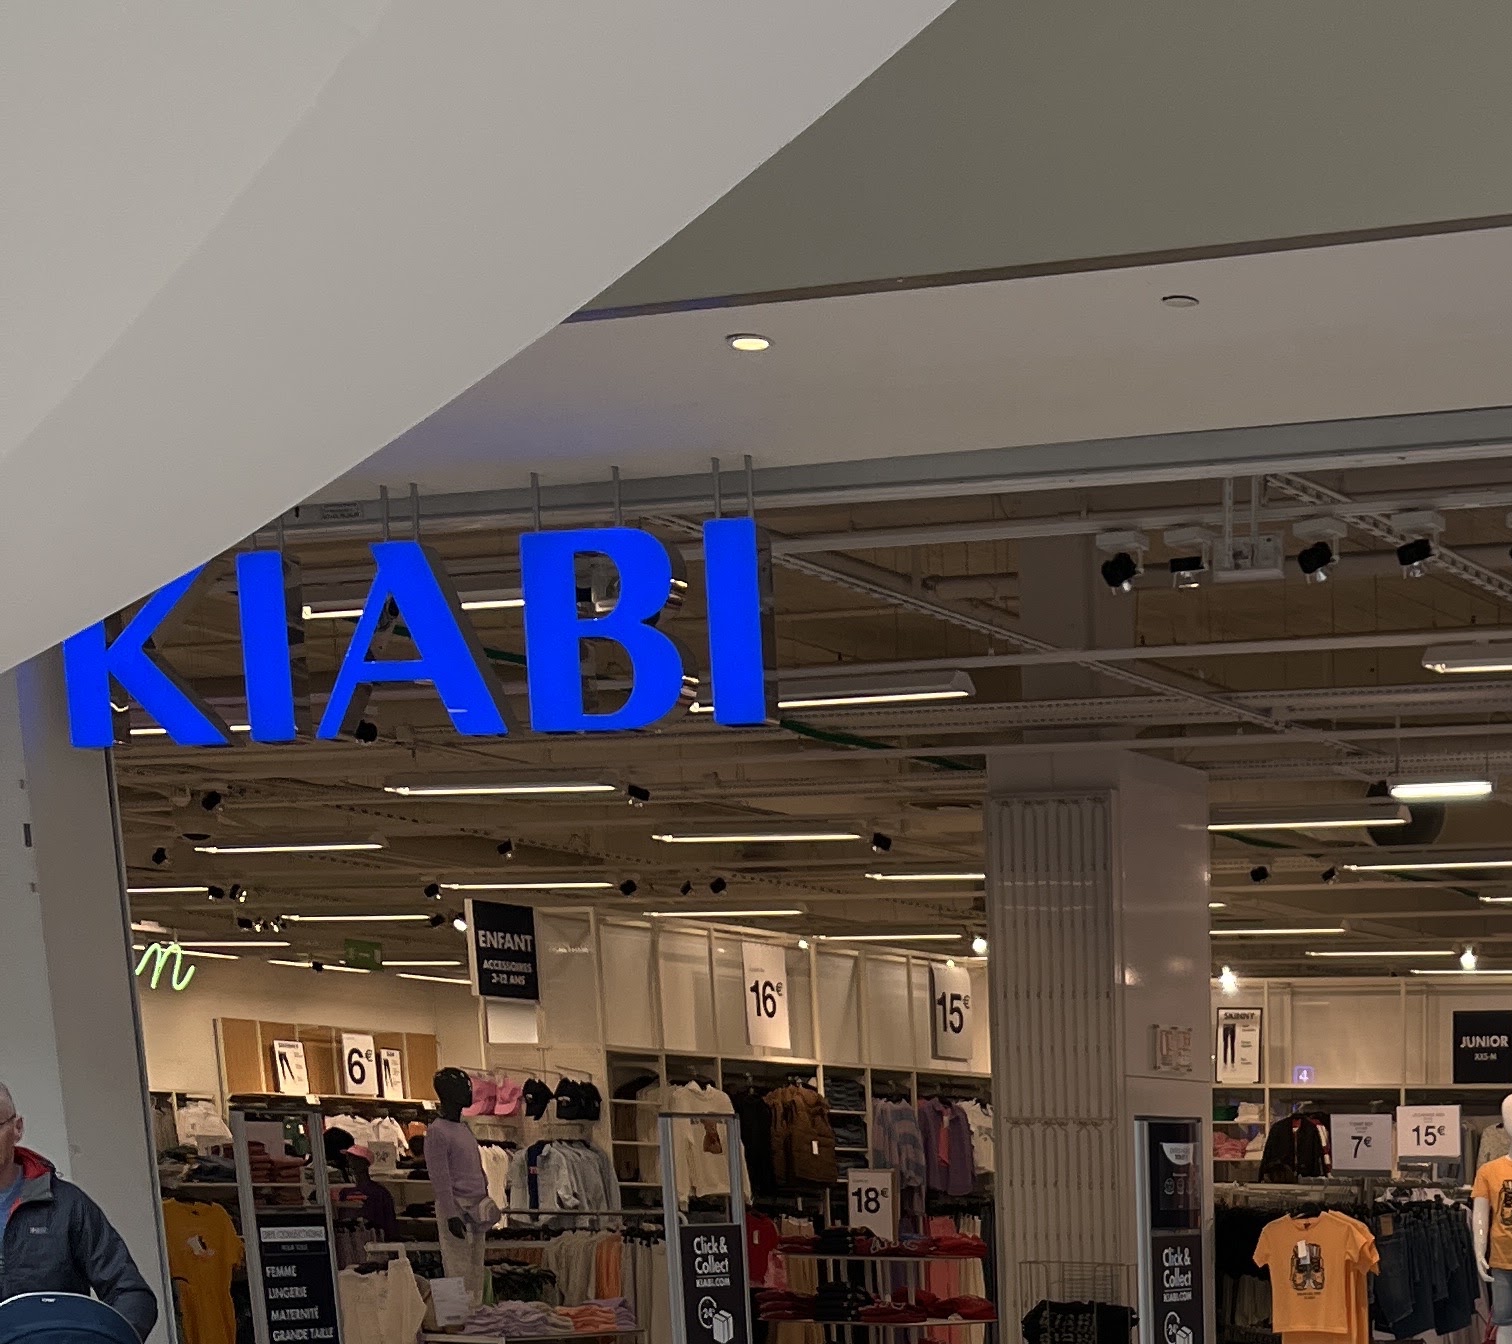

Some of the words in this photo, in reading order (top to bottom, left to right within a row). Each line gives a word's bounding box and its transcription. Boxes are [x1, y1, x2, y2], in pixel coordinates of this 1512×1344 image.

[63, 517, 766, 748] KIABI
[478, 930, 533, 952] ENFANT
[482, 959, 533, 974] ACCESSOIRES
[509, 975, 526, 986] ANS
[750, 979, 784, 1018] 16€
[937, 991, 971, 1034] 15€
[1460, 1035, 1509, 1048] JUNIOR
[347, 1047, 373, 1085] 6€
[1412, 1125, 1446, 1146] 15€
[1351, 1136, 1372, 1158] 7€
[851, 1187, 889, 1214] 18€
[693, 1235, 718, 1254] Click
[719, 1236, 728, 1253] &
[694, 1254, 729, 1274] Collect
[1162, 1246, 1184, 1267] Click
[1184, 1247, 1191, 1266] &
[265, 1265, 297, 1278] FEMME
[1163, 1267, 1192, 1288] Collect
[267, 1286, 308, 1299] LINGERIE
[271, 1305, 319, 1321] MATERNITÉ
[272, 1329, 310, 1342] GRANDE
[309, 1326, 334, 1339] TAILLE
